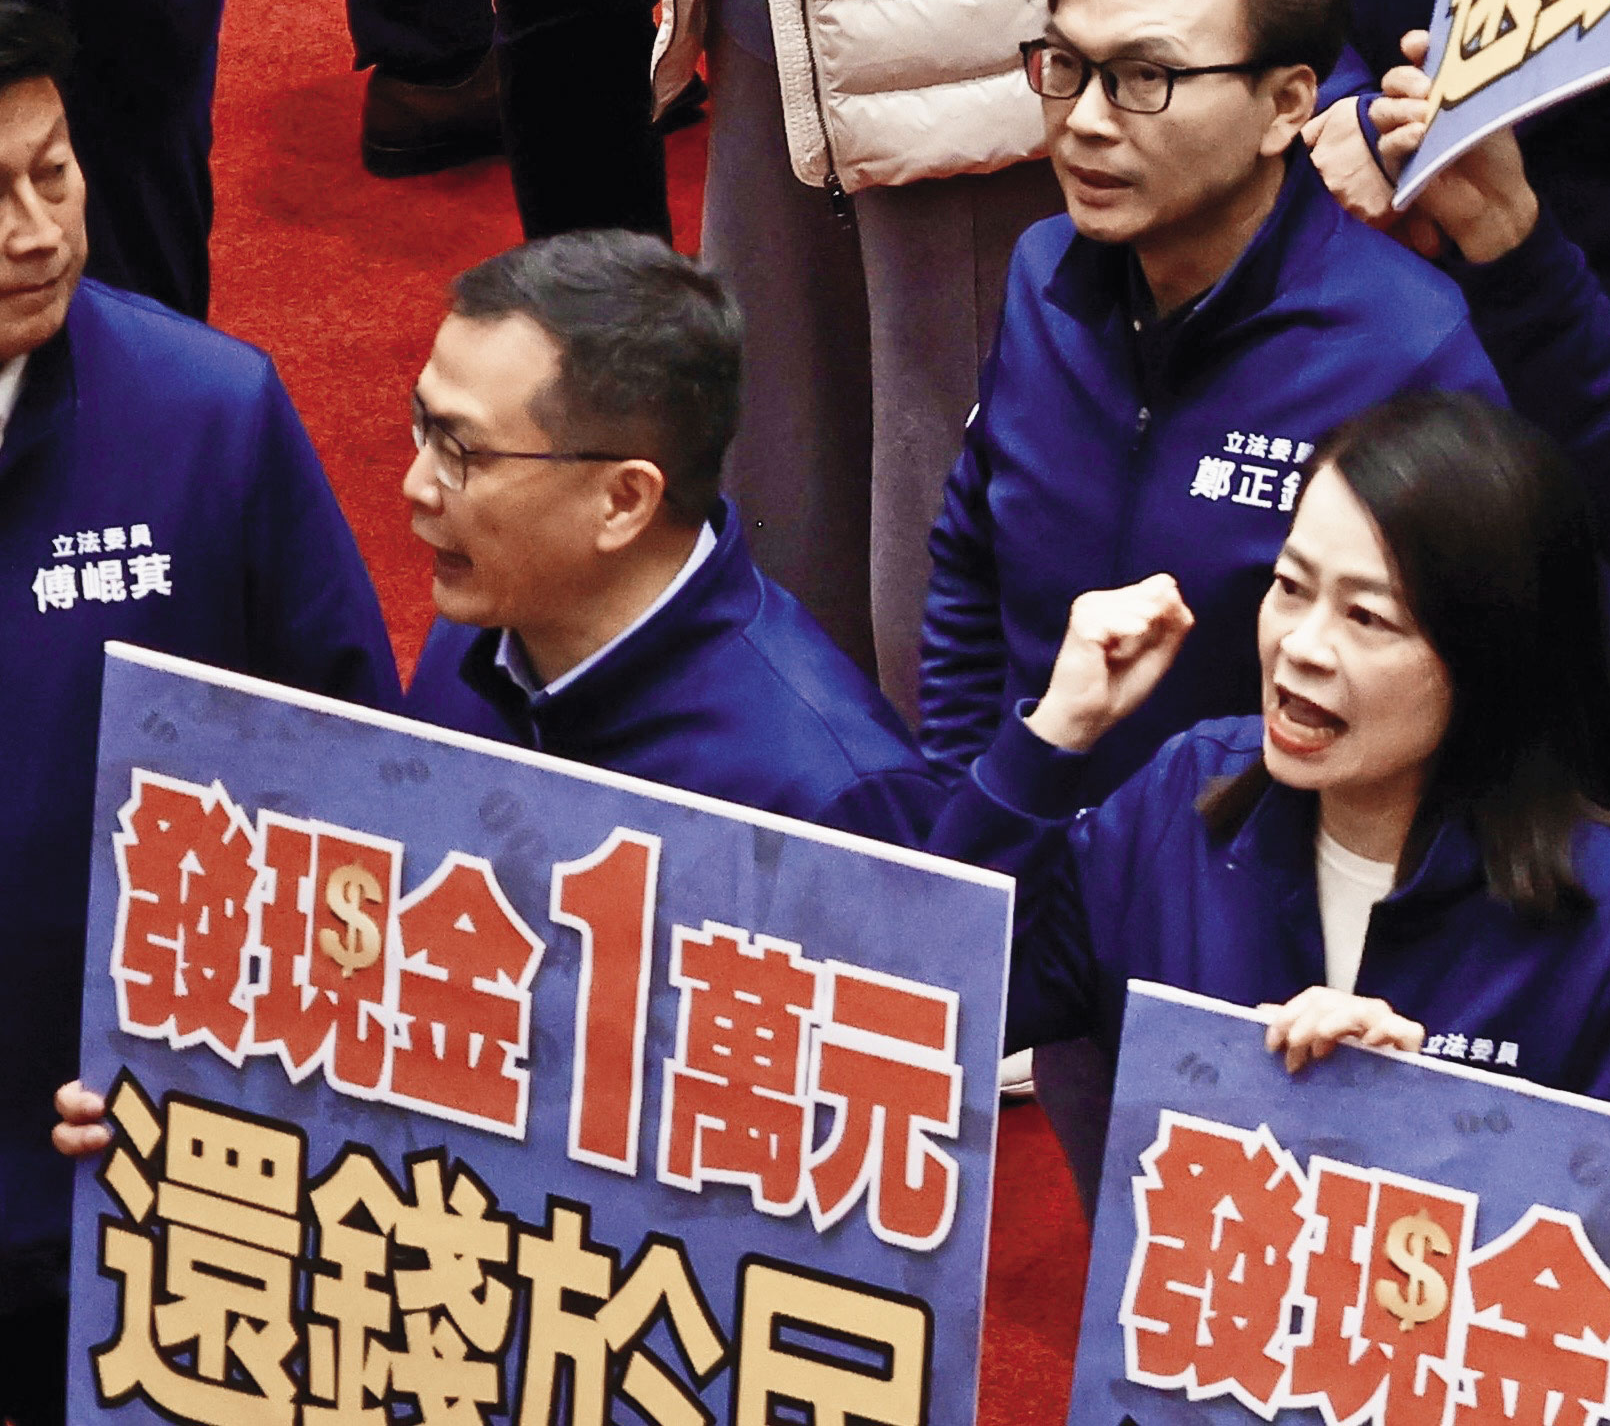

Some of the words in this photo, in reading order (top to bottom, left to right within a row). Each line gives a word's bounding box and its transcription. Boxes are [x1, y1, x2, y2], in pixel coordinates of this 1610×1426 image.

[52, 524, 152, 558] 立法委員
[110, 766, 962, 1252] 發現金1萬元
[1422, 1033, 1519, 1066] 立法委員
